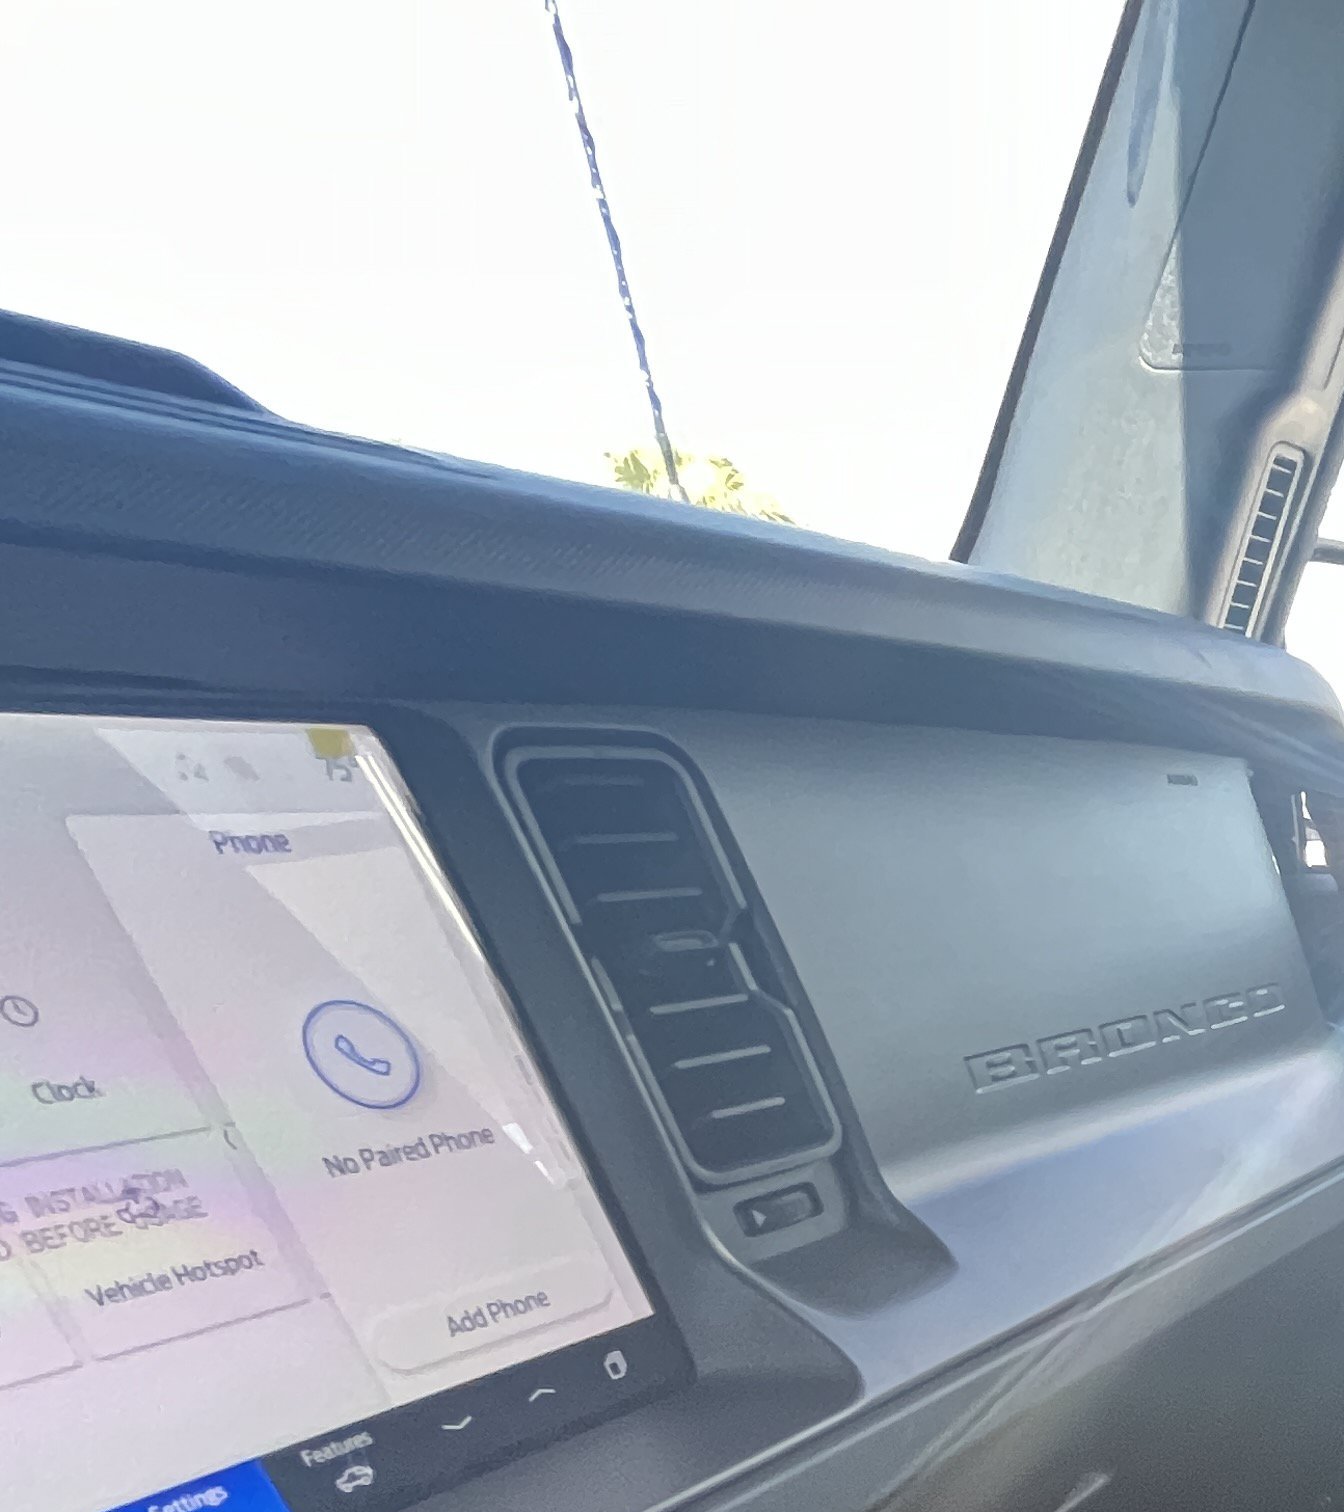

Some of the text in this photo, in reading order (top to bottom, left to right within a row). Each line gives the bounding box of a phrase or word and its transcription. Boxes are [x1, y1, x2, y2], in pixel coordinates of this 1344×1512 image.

[211, 831, 292, 855] Phone
[963, 983, 1285, 1094] BRONCO
[31, 1076, 103, 1105] Clock
[323, 1124, 496, 1179] No Paired Phone
[20, 1214, 124, 1254] BEFORE
[84, 1249, 265, 1311] Vehicle Hotspot
[446, 1290, 551, 1337] Add Phone
[301, 1431, 374, 1467] Features
